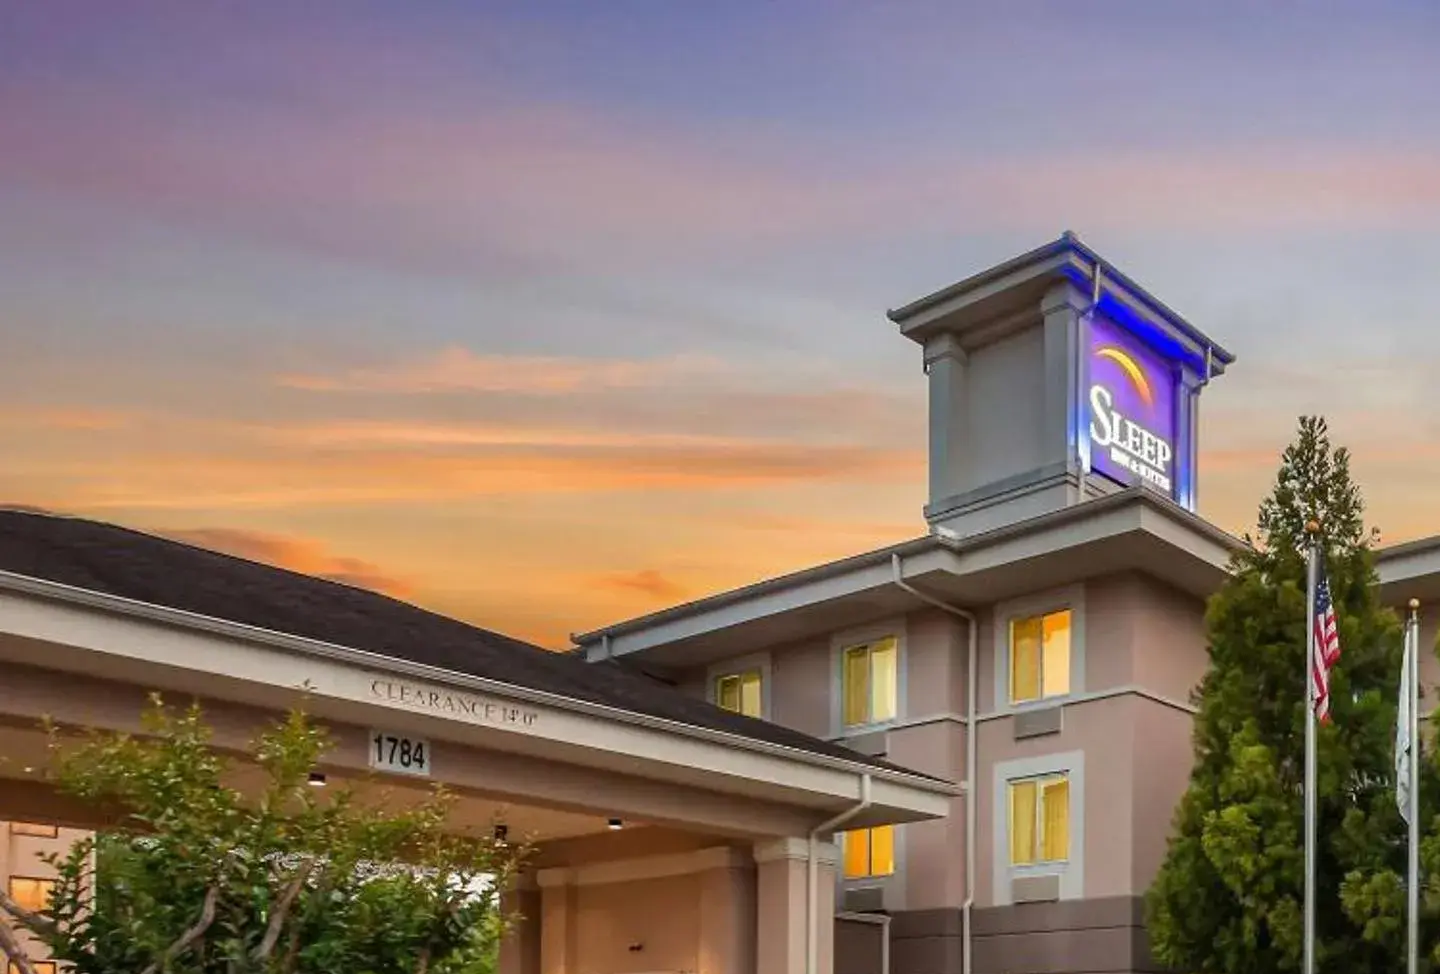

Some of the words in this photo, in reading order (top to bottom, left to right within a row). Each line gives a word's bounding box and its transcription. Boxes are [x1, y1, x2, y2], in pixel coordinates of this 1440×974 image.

[1090, 385, 1171, 473] SLEEP
[369, 679, 497, 720] CLEARANCE
[373, 734, 425, 769] 1784
